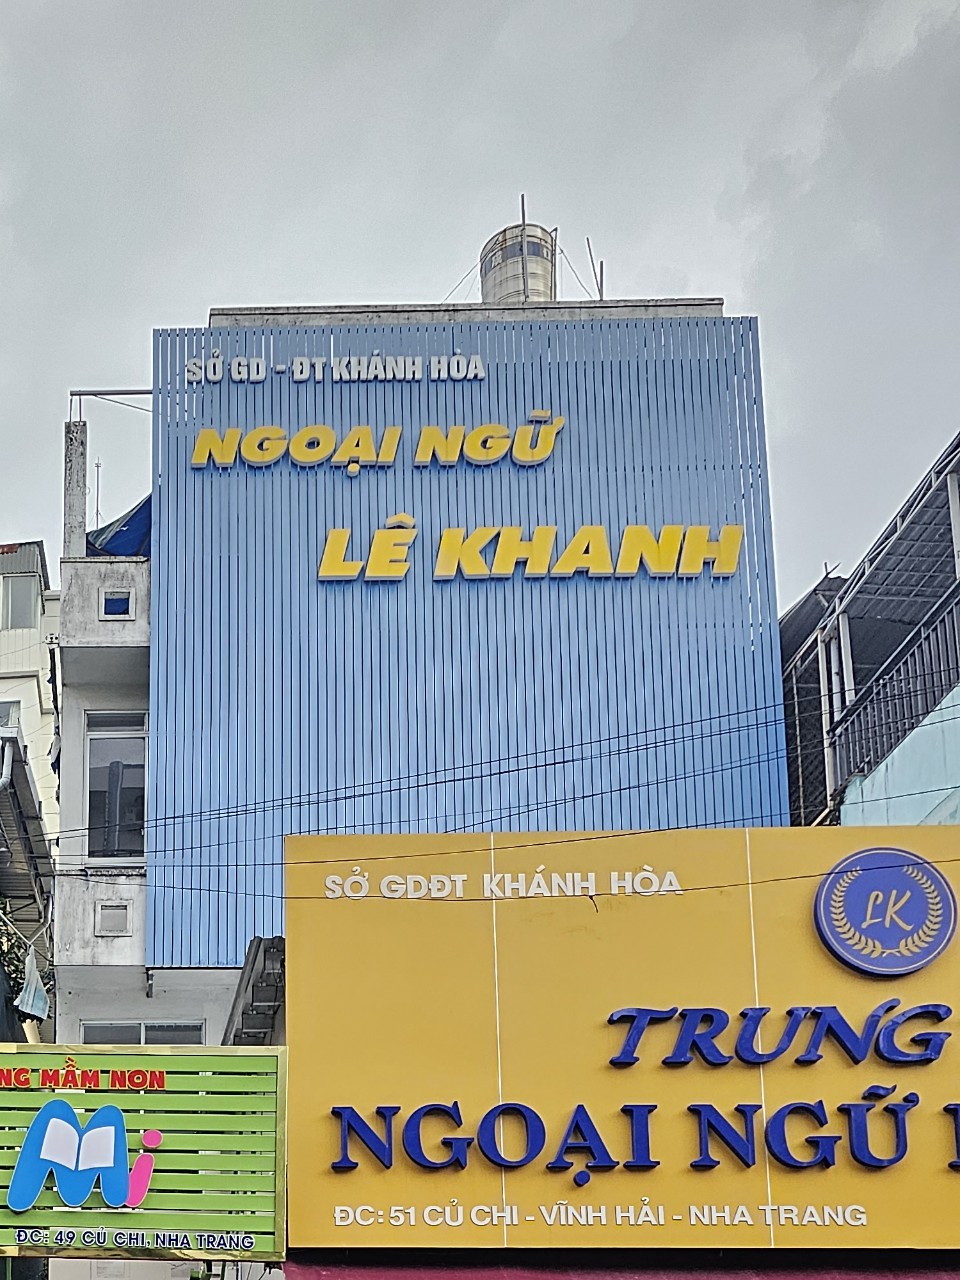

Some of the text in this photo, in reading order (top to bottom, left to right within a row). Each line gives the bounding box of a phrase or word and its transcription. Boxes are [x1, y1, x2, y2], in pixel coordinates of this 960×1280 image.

[187, 348, 224, 383] SỞ
[230, 356, 267, 383] GD
[292, 356, 327, 383] ĐT
[333, 349, 423, 382] KHÁNH
[430, 348, 486, 381] HÒA
[190, 409, 565, 477] NGOẠI NGỮ
[318, 512, 744, 582] LÊ KHANH
[324, 864, 684, 899] SỞ GDĐT KHÁNH HÒA
[861, 889, 914, 931] LK
[607, 998, 953, 1068] TRUNG
[39, 1056, 101, 1089] MẦM
[109, 1068, 166, 1090] NON
[6, 1098, 165, 1213] Mi
[330, 1100, 661, 1188] NGOẠI
[688, 1083, 920, 1171] NGỮ
[333, 1205, 384, 1226] ĐC:
[389, 1205, 416, 1226] 51
[422, 1198, 464, 1227] CỦ
[470, 1205, 519, 1226] CHI
[539, 1200, 606, 1226] VĨNH
[615, 1197, 665, 1225] HẢI
[690, 1205, 754, 1226] NHA
[758, 1205, 867, 1226] TRANG
[15, 1226, 255, 1250] ĐC: 49 CỦ CHI, NHA TRANG
